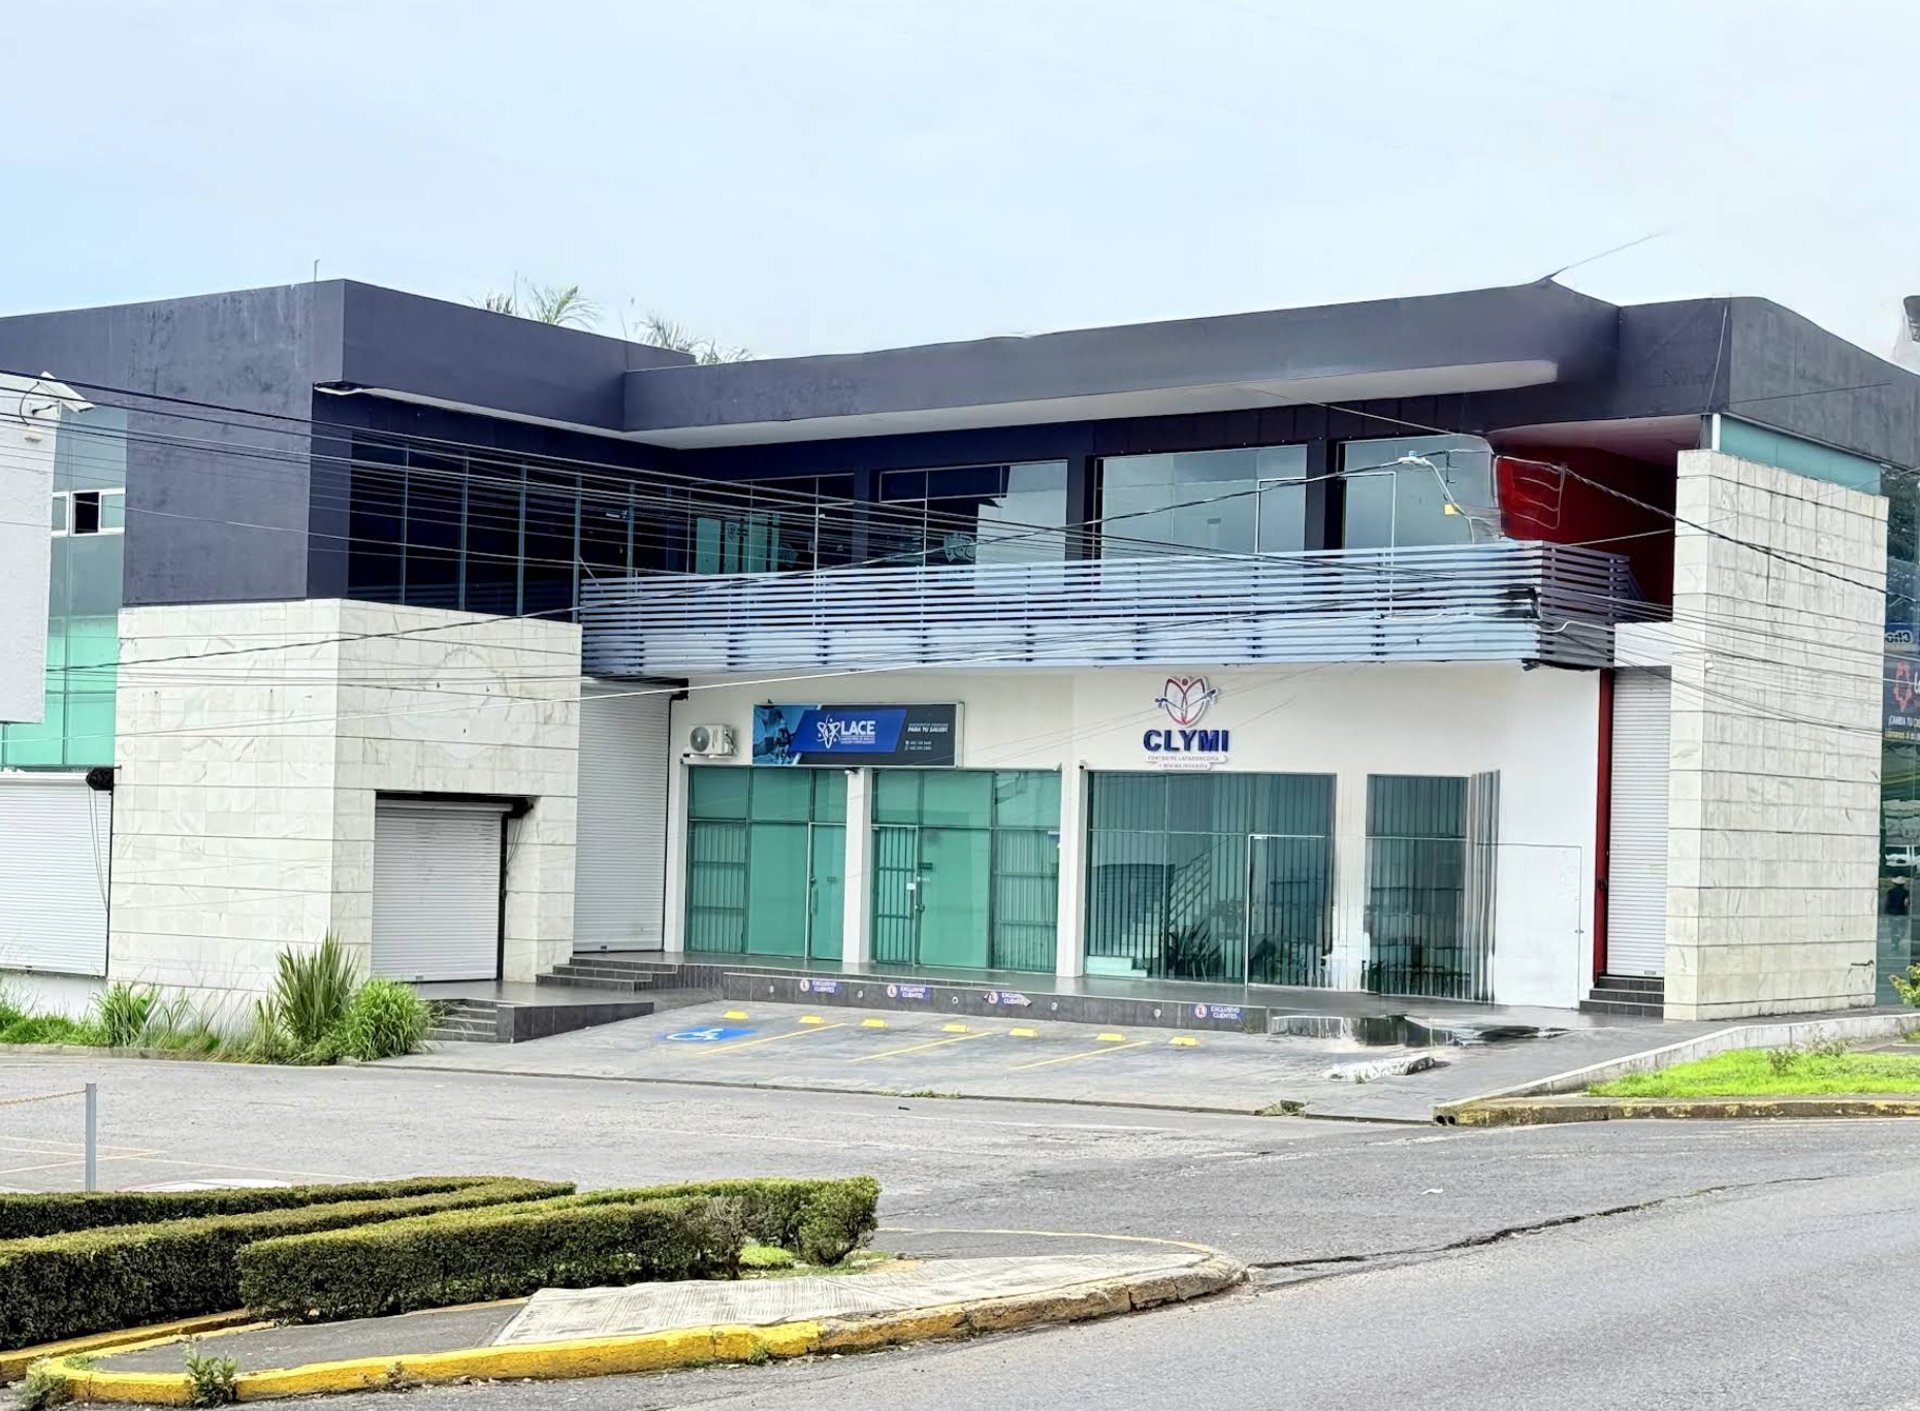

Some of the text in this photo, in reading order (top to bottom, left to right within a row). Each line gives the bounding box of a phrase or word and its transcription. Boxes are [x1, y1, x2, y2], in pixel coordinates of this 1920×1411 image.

[841, 720, 876, 736] LACE
[1143, 729, 1229, 752] CLYMI
[812, 980, 837, 988] EXCLUSIVO
[900, 985, 926, 993] EXCLUSIVO
[1210, 1005, 1240, 1014] EXCLUSIVO
[1212, 1012, 1238, 1020] CLIENTES
